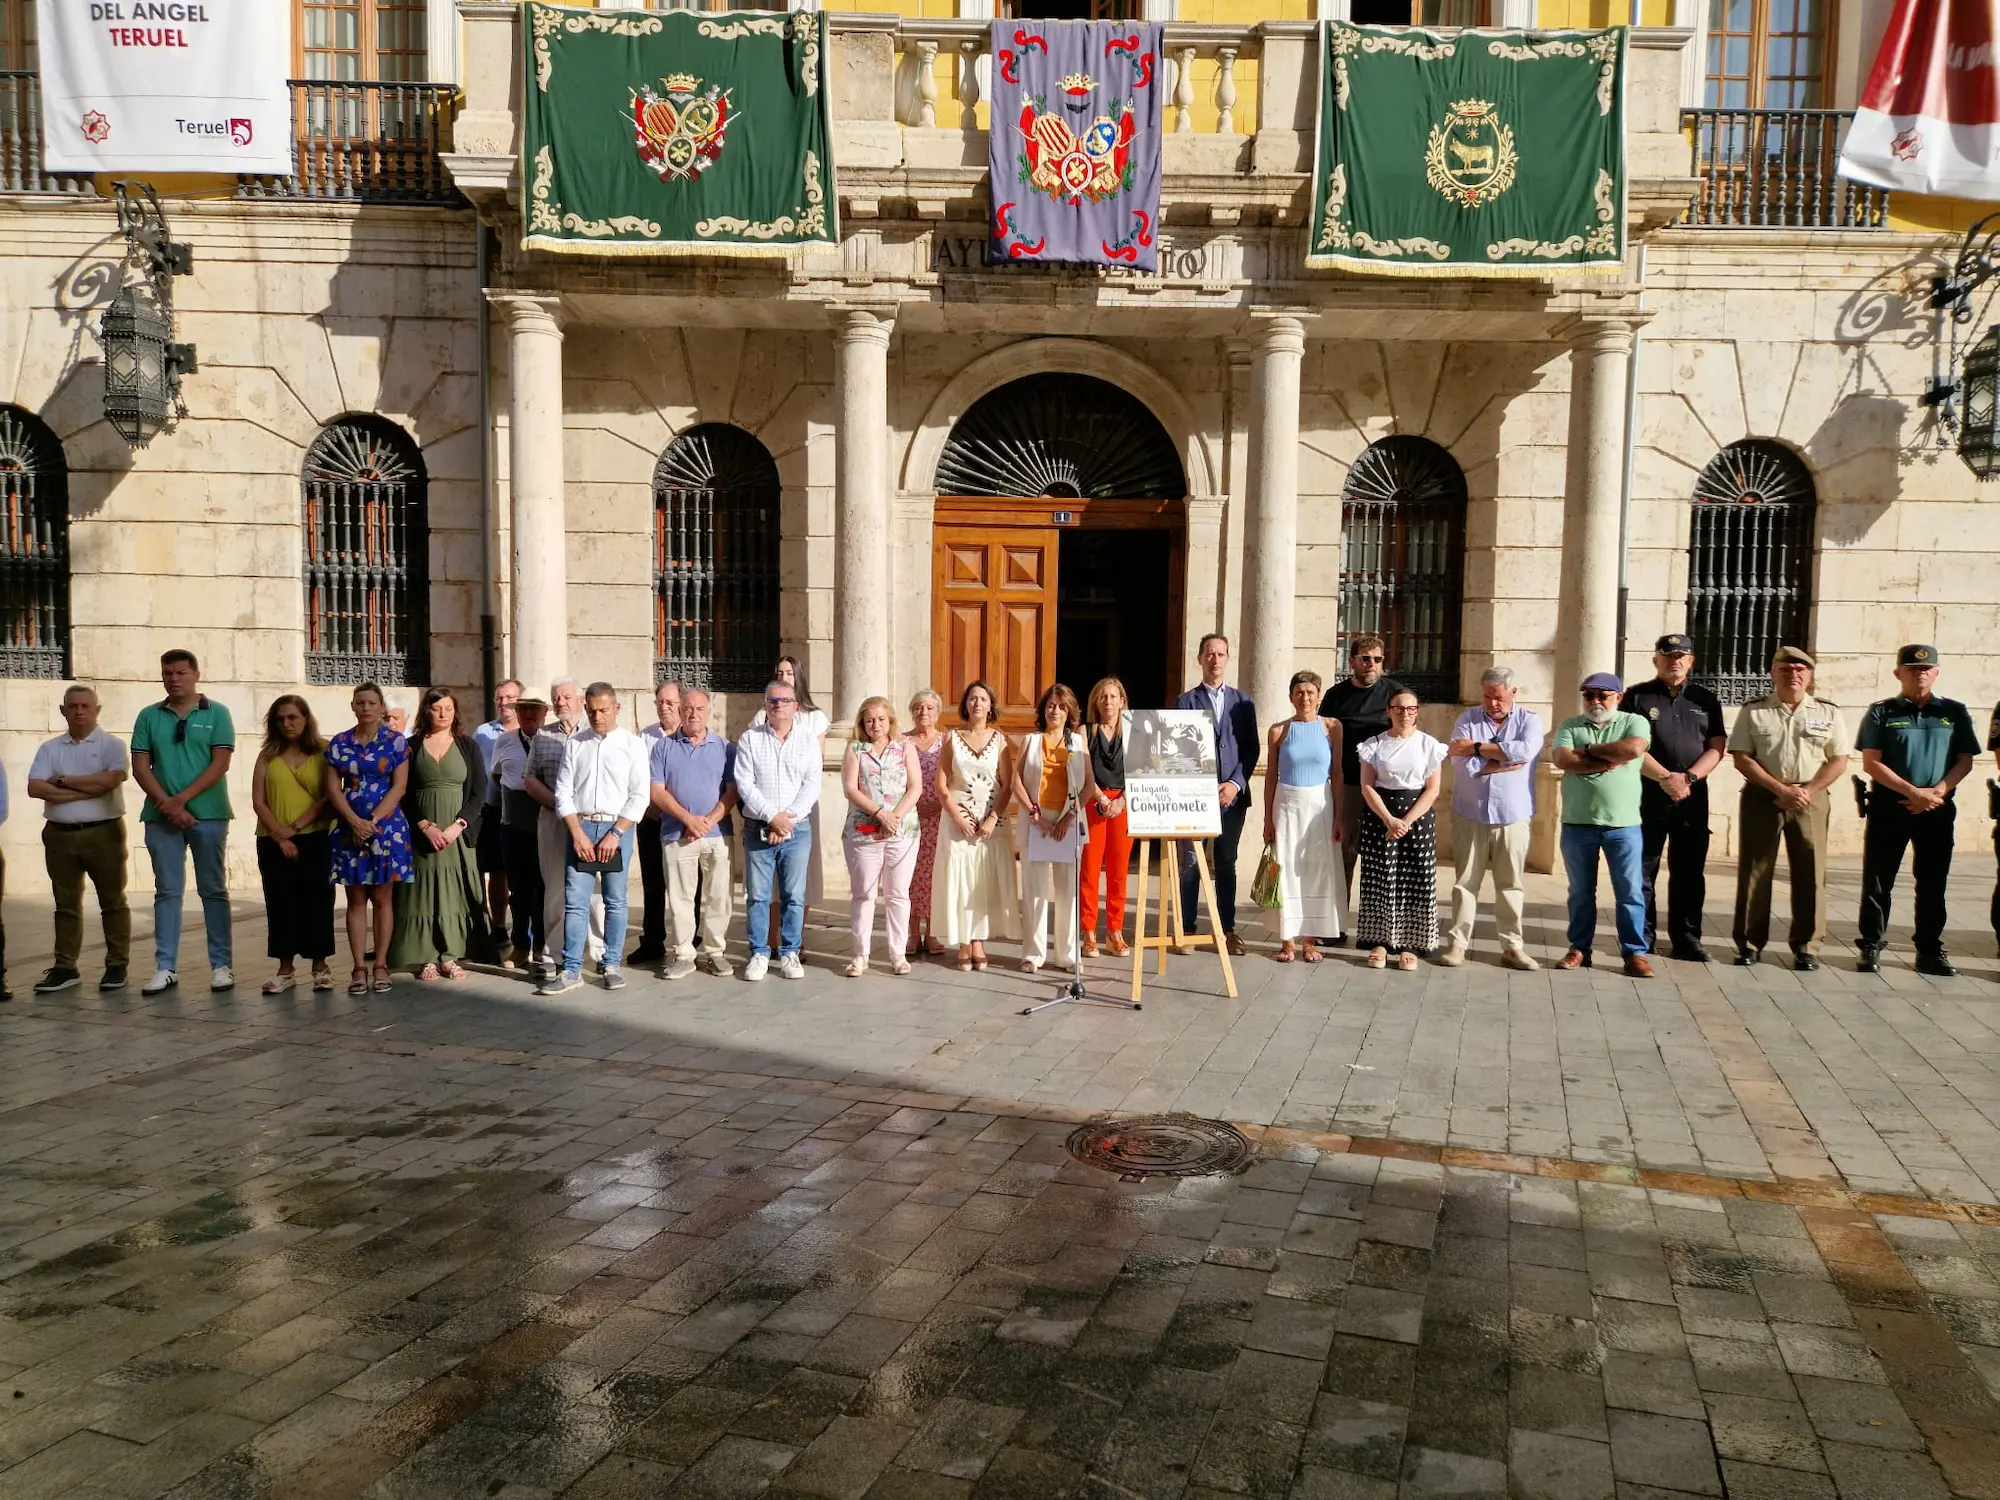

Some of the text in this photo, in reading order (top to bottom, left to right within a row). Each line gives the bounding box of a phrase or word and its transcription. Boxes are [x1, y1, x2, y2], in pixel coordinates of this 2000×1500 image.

[91, 3, 125, 21] DEL
[109, 27, 188, 47] TERUEL
[175, 119, 229, 134] Teruel
